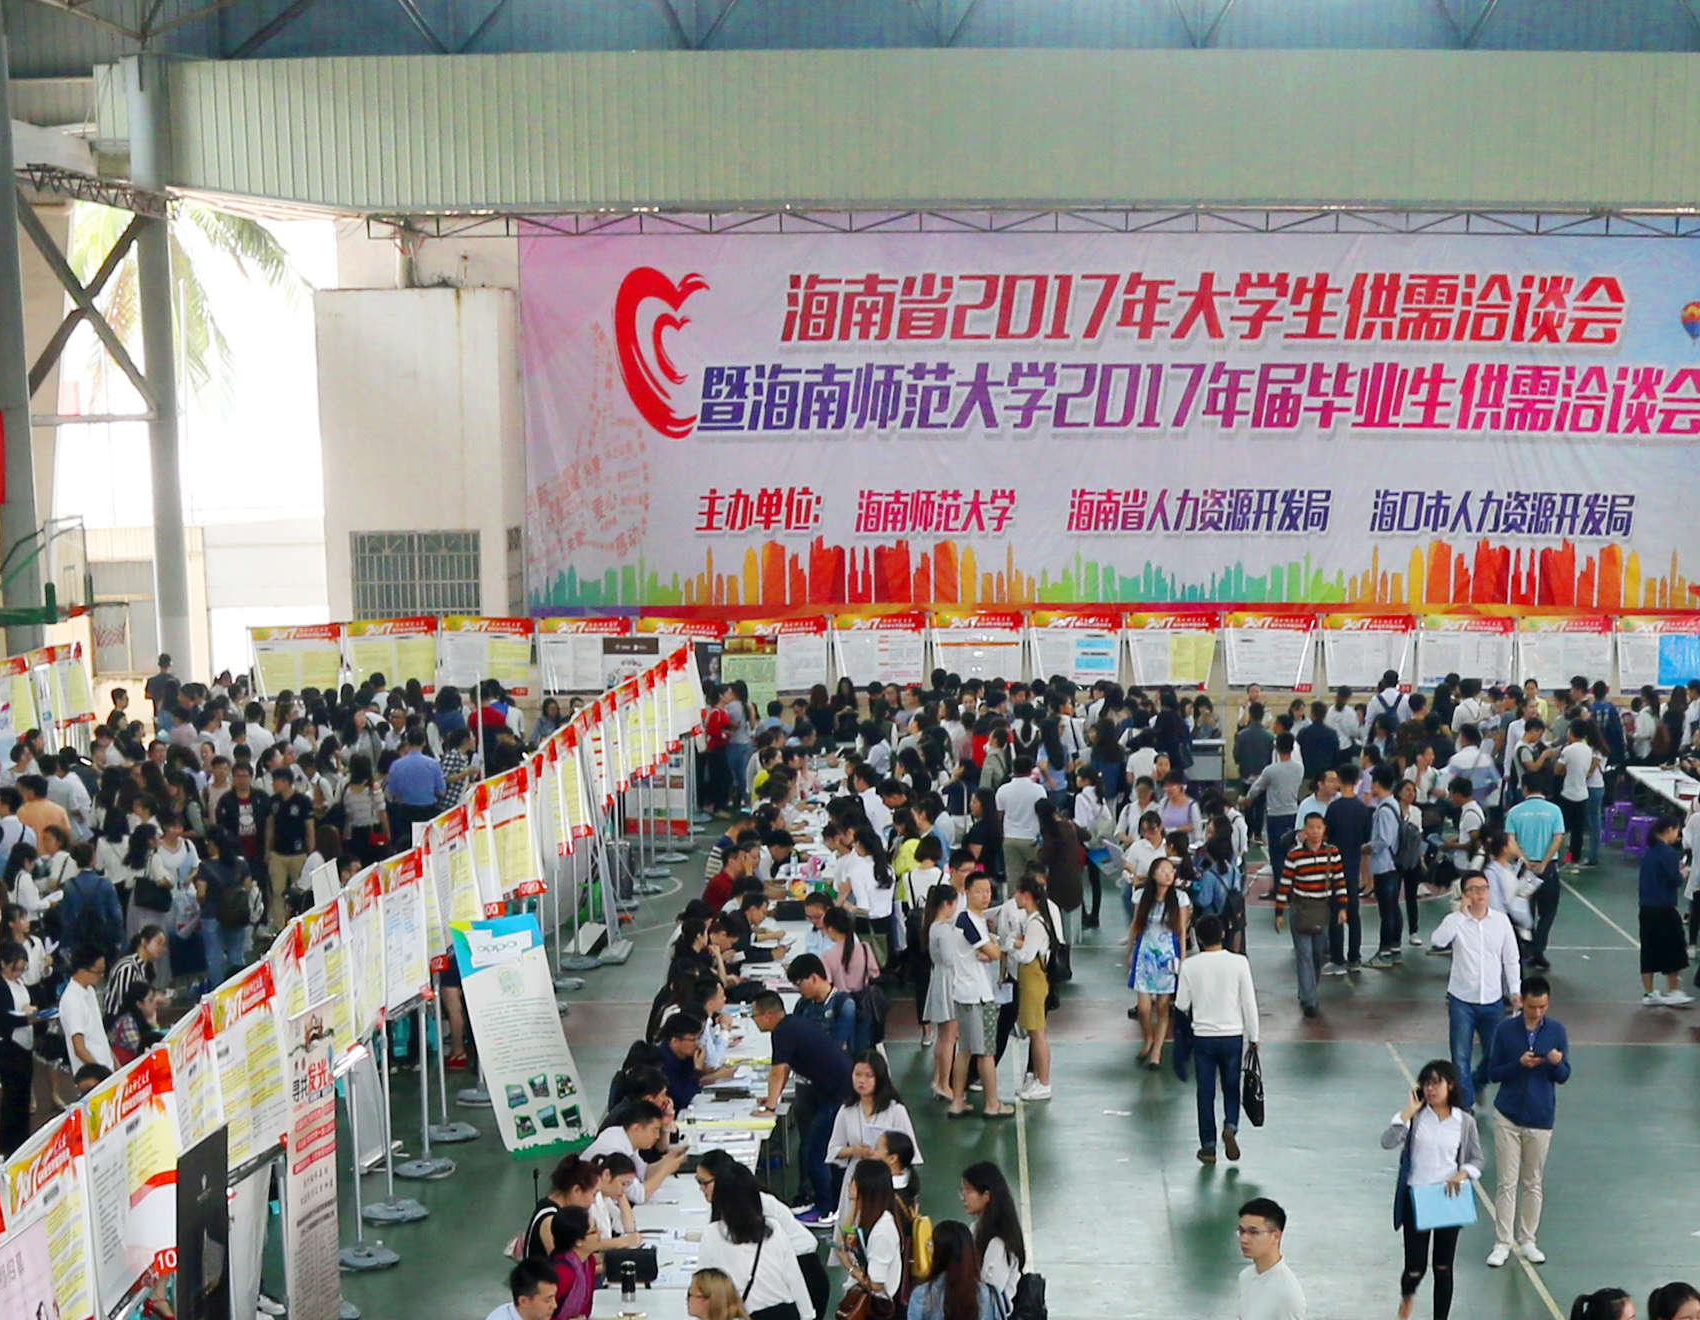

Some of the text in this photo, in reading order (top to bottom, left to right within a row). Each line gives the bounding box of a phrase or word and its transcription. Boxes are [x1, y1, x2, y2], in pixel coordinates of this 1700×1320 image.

[779, 271, 1627, 346] 海南省2017年大学生供需洽谈会
[855, 488, 1015, 534] 海南师范大学
[1067, 488, 1332, 536] 海南省人力资源开发局
[1370, 490, 1636, 537] 海口市人力资源开发局
[157, 1250, 178, 1268] 10
